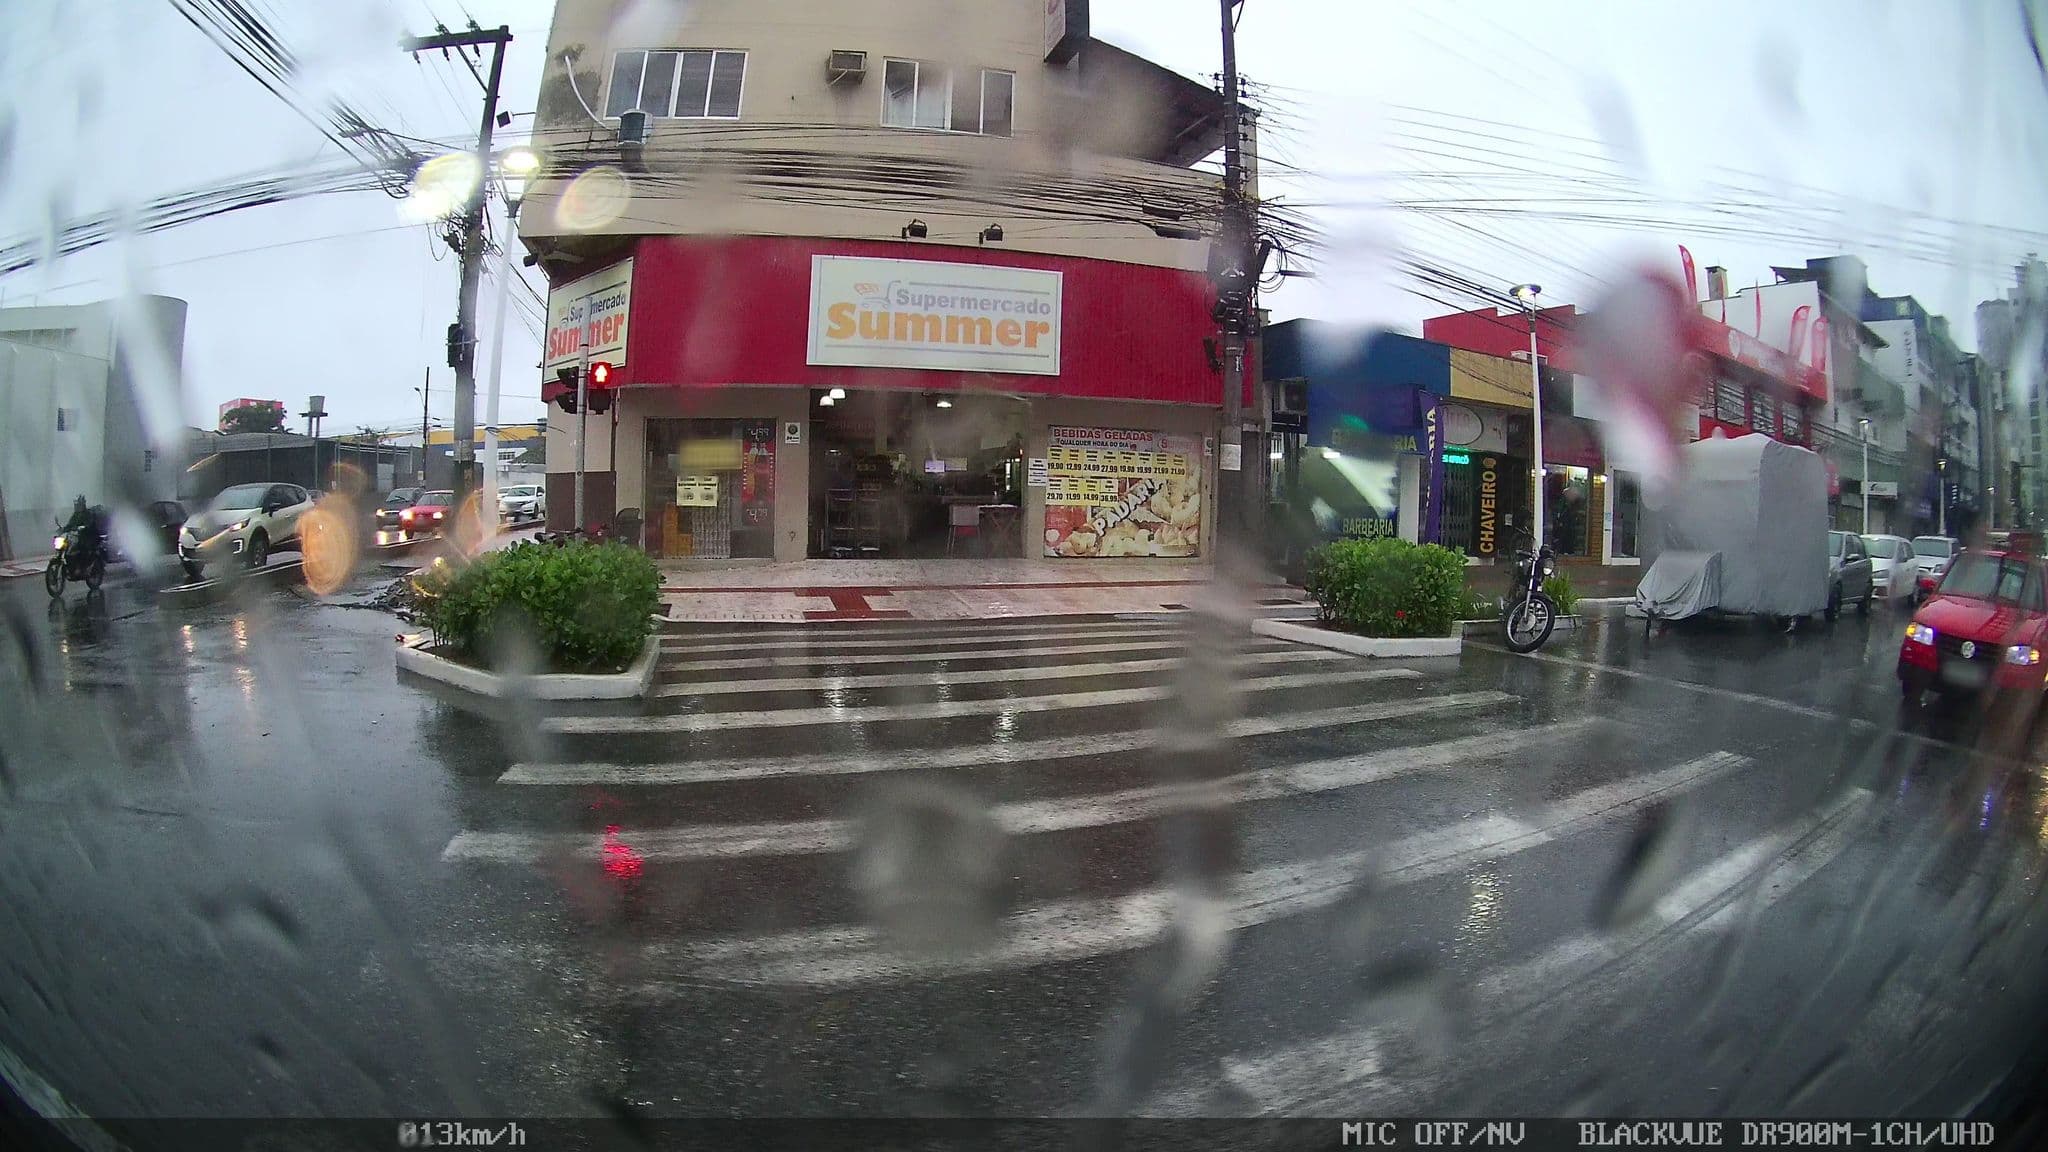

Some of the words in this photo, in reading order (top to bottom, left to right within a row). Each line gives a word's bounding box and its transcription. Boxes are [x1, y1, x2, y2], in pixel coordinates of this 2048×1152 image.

[569, 291, 626, 322] Supmercado
[896, 288, 1052, 316] Supermercado
[826, 302, 1051, 348] Summer
[1053, 428, 1101, 440] BEBIDAS
[1104, 430, 1153, 442] GELADAS
[1060, 439, 1092, 447] QUALQUER
[1480, 470, 1497, 554] CHAVEIRO
[1342, 518, 1394, 535] BARBEARIA
